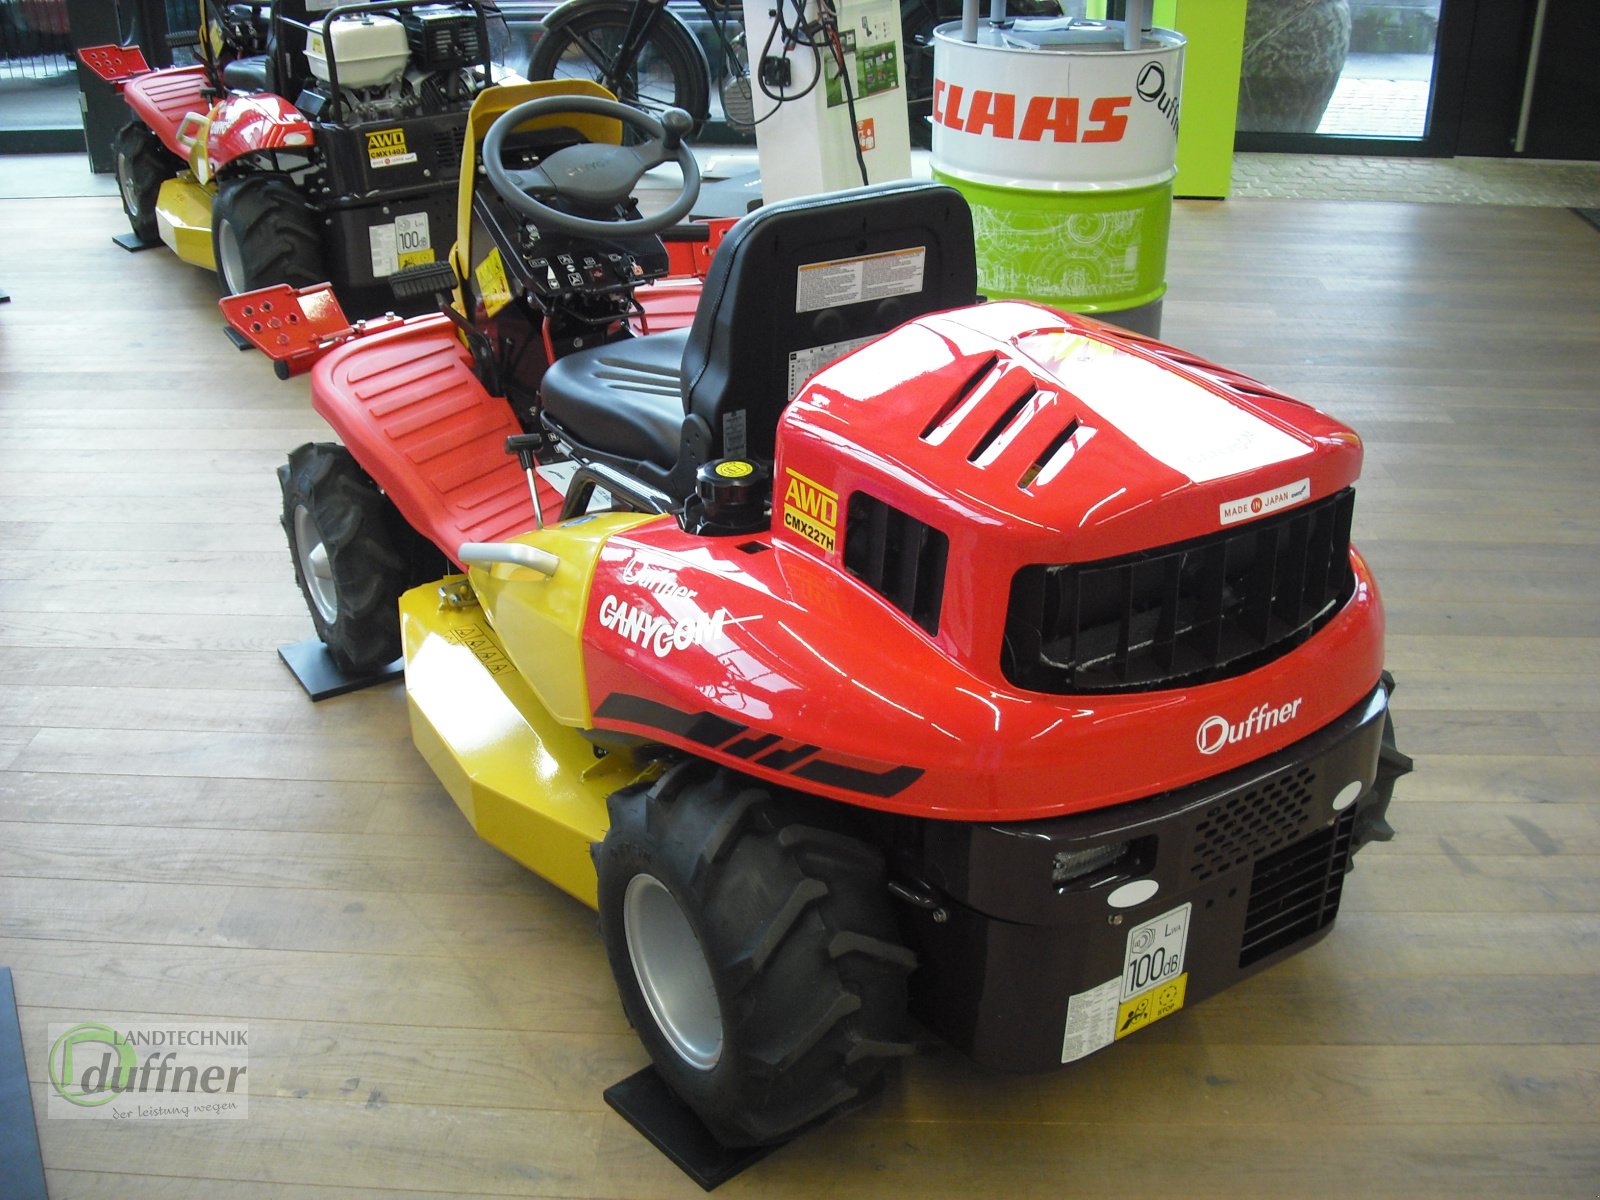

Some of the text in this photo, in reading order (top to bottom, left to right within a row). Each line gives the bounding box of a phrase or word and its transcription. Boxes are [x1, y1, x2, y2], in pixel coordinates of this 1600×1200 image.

[933, 78, 1132, 143] CLAAS
[368, 132, 405, 148] AWD
[785, 478, 837, 527] AWD
[1224, 504, 1248, 517] MADE
[1264, 491, 1289, 506] JAPAN
[784, 512, 834, 551] CMX227H
[599, 594, 726, 657] CANYCOM
[1196, 697, 1303, 755] Duffner
[1157, 1003, 1175, 1016] STOP
